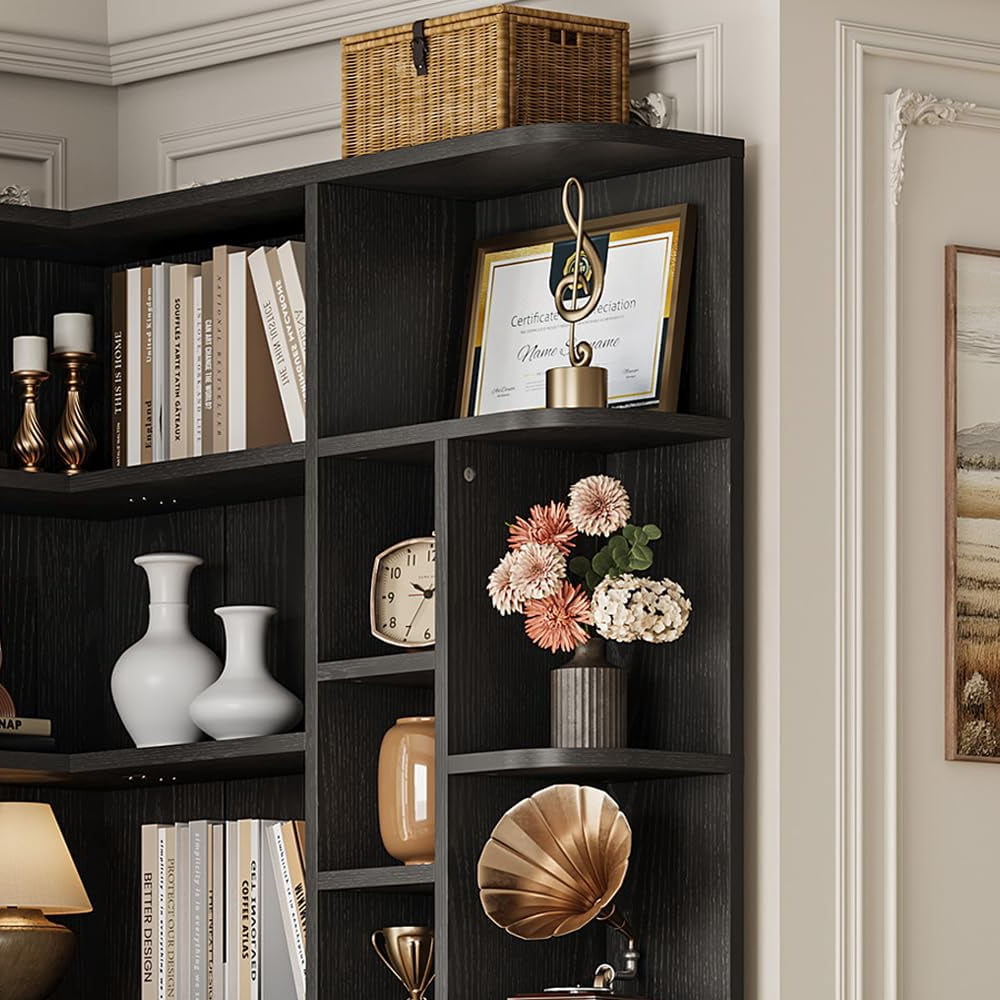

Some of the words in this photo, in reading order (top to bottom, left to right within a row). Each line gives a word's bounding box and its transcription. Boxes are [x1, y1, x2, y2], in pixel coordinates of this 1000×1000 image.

[145, 287, 153, 329] Kingdom
[510, 311, 559, 327] Certificate
[114, 331, 122, 370] HOME
[145, 331, 153, 363] United
[517, 344, 558, 362] Name
[114, 372, 122, 385] IS
[114, 386, 122, 416] THIS
[144, 400, 153, 449] England
[390, 567, 402, 579] 10
[407, 553, 416, 567] 11
[387, 591, 395, 604] 9
[389, 616, 397, 629] 8
[405, 625, 412, 637] 7
[423, 627, 431, 640] 6
[144, 872, 152, 924] BETTER
[167, 858, 175, 919] PROTECT
[241, 879, 249, 921] COFFEE
[167, 919, 175, 948] OUR
[241, 925, 249, 959] ATLAS
[144, 928, 152, 983] DESIGN
[167, 950, 175, 997] DESIGN
